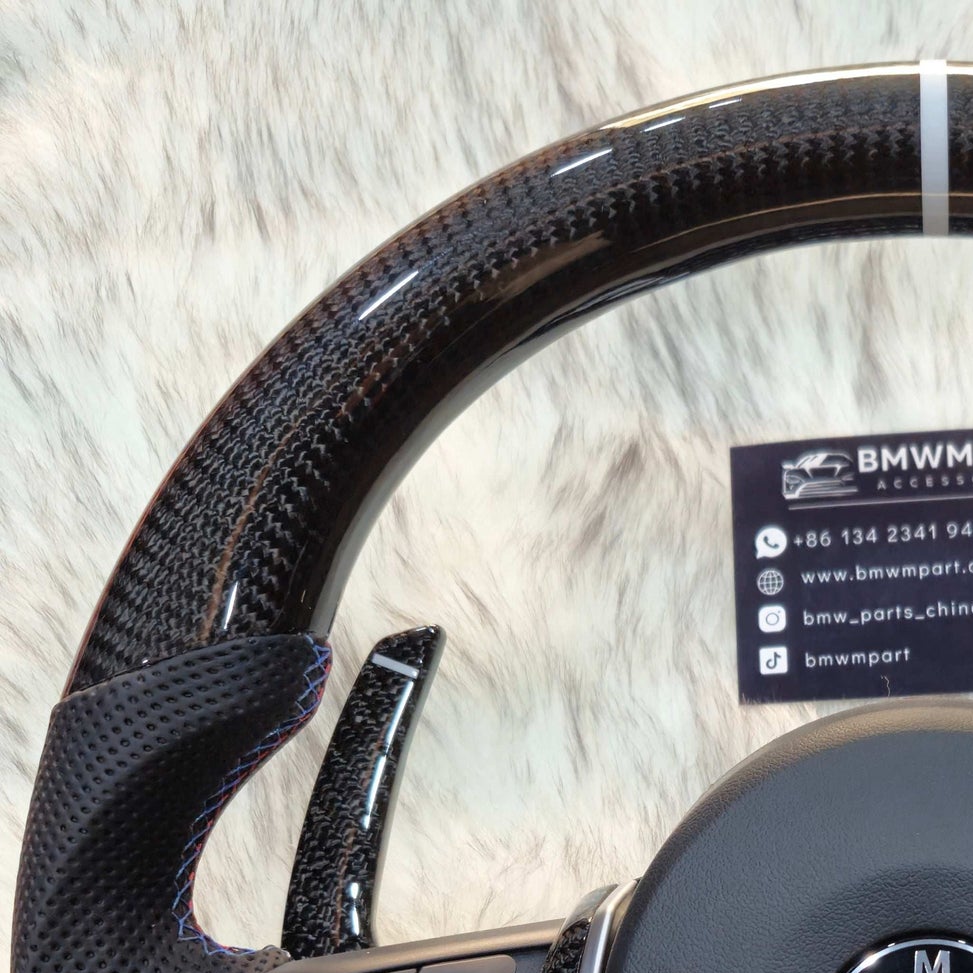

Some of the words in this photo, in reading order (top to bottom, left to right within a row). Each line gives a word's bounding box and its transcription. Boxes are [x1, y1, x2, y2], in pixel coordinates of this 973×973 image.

[793, 528, 831, 548] +86
[841, 526, 877, 545] 134
[887, 523, 937, 543] 2341
[805, 647, 911, 669] bmwmpart
